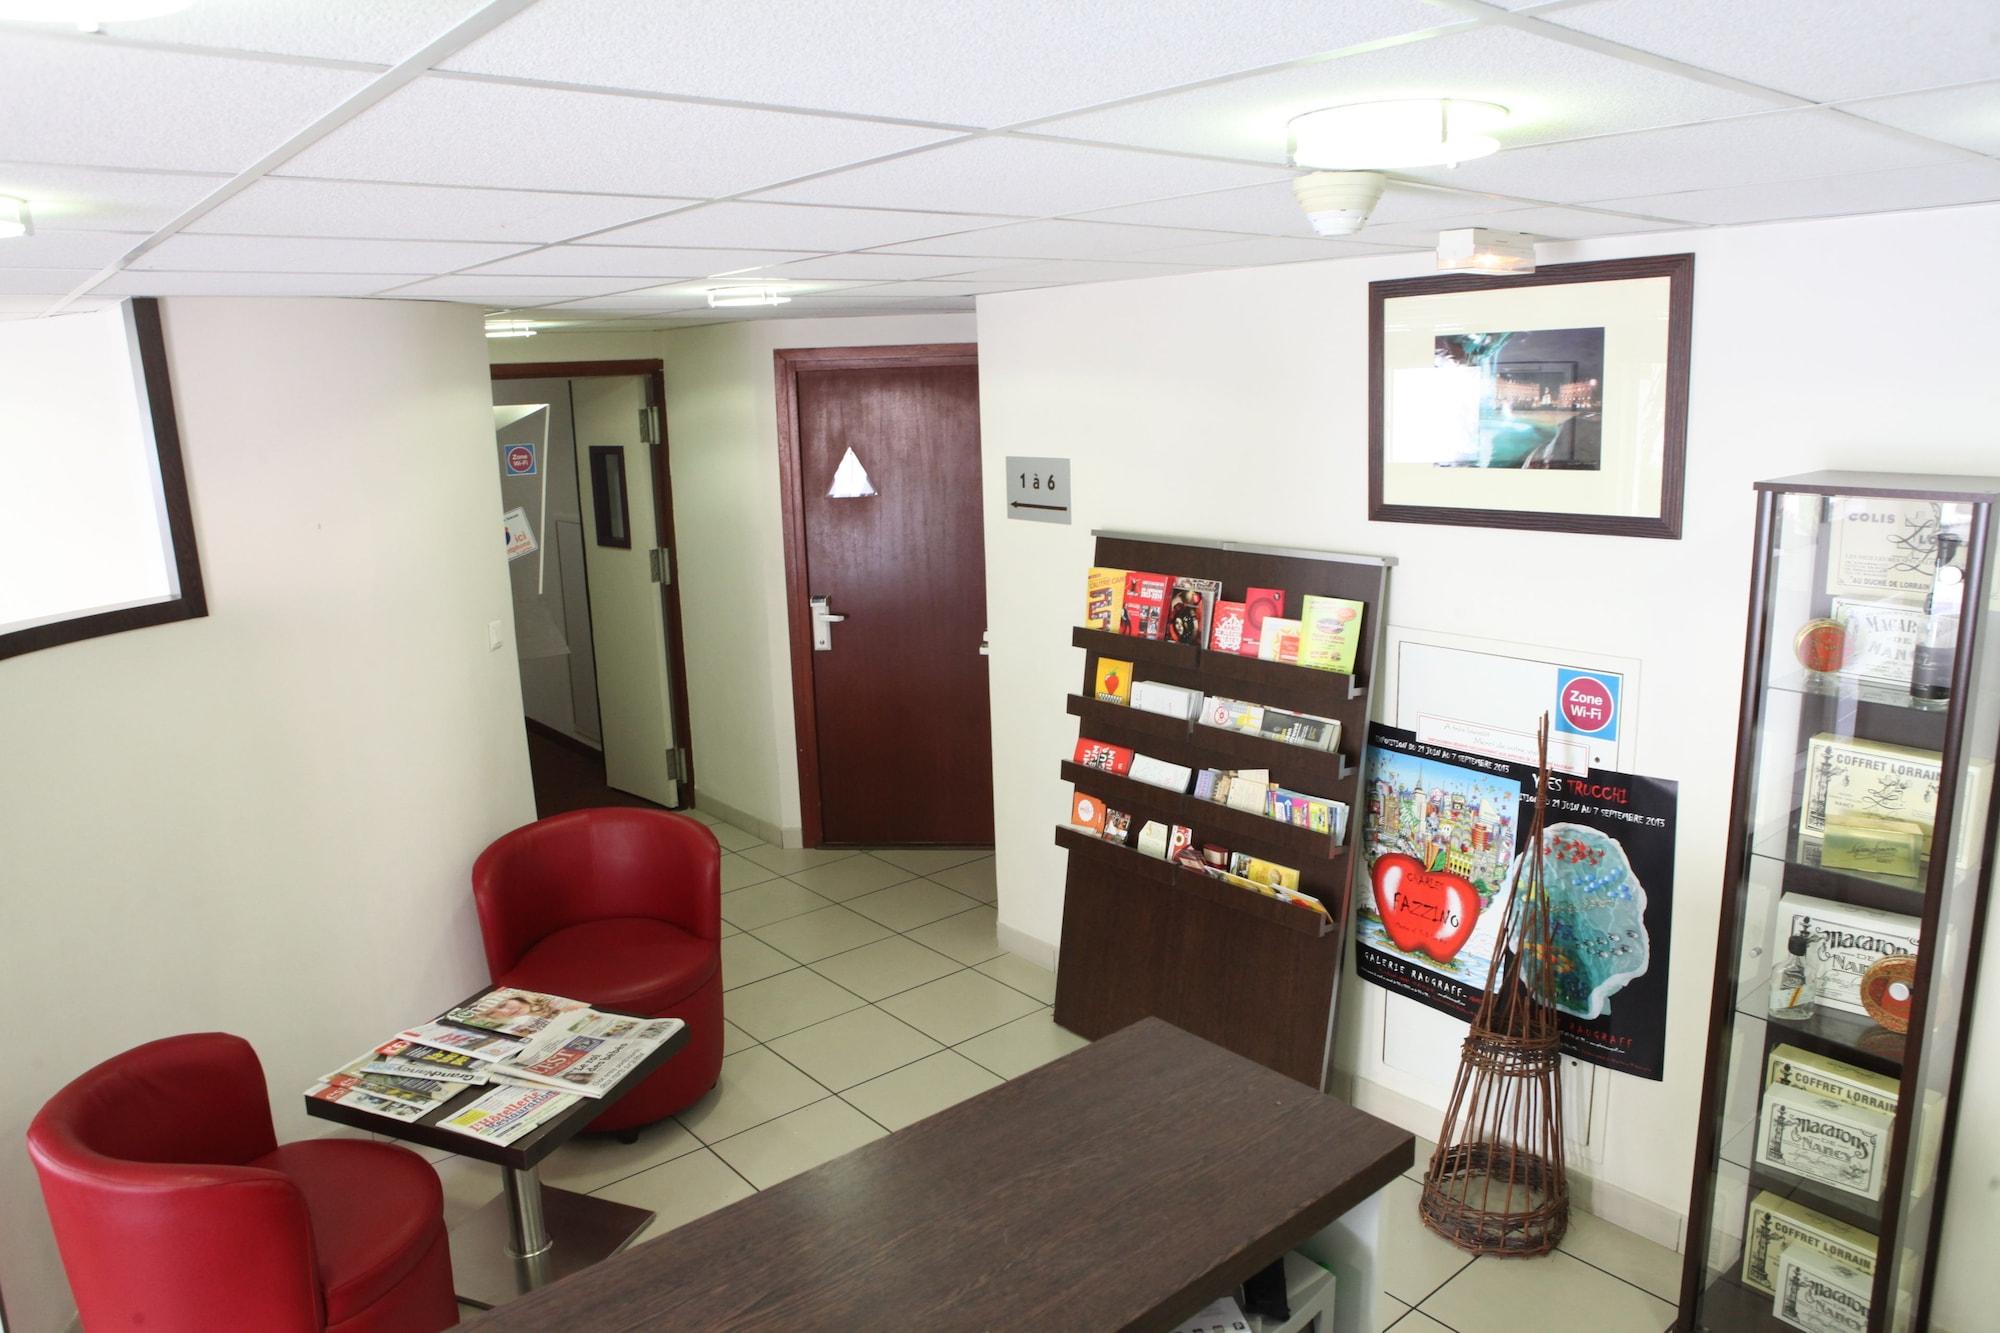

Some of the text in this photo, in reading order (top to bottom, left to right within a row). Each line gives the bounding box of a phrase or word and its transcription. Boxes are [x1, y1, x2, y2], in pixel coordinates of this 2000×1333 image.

[1019, 472, 1056, 491] 1 à 6
[1847, 512, 1897, 525] COLIS
[1899, 581, 1932, 590] LORRAIN
[1865, 615, 1918, 633] MACAR
[1569, 690, 1604, 706] Zone
[1570, 704, 1603, 721] Wi-Fi
[1836, 754, 1888, 772] COFFRET
[1532, 773, 1631, 804] YES TRUCCHI
[1561, 800, 1580, 812] JUIN
[1580, 804, 1592, 814] AU
[1593, 806, 1599, 815] 7
[1600, 808, 1645, 825] SEPTEMBRE
[1645, 816, 1666, 828] 2013
[1393, 892, 1459, 928] FAZZINO
[1815, 927, 1910, 957] Macaron
[1364, 951, 1406, 974] GALERIE
[1794, 1072, 1844, 1096] COFFRET
[1793, 1116, 1869, 1160] Macarons
[1774, 1221, 1872, 1270] COFFRET LORRAIN
[1804, 1279, 1869, 1317] Macaron
